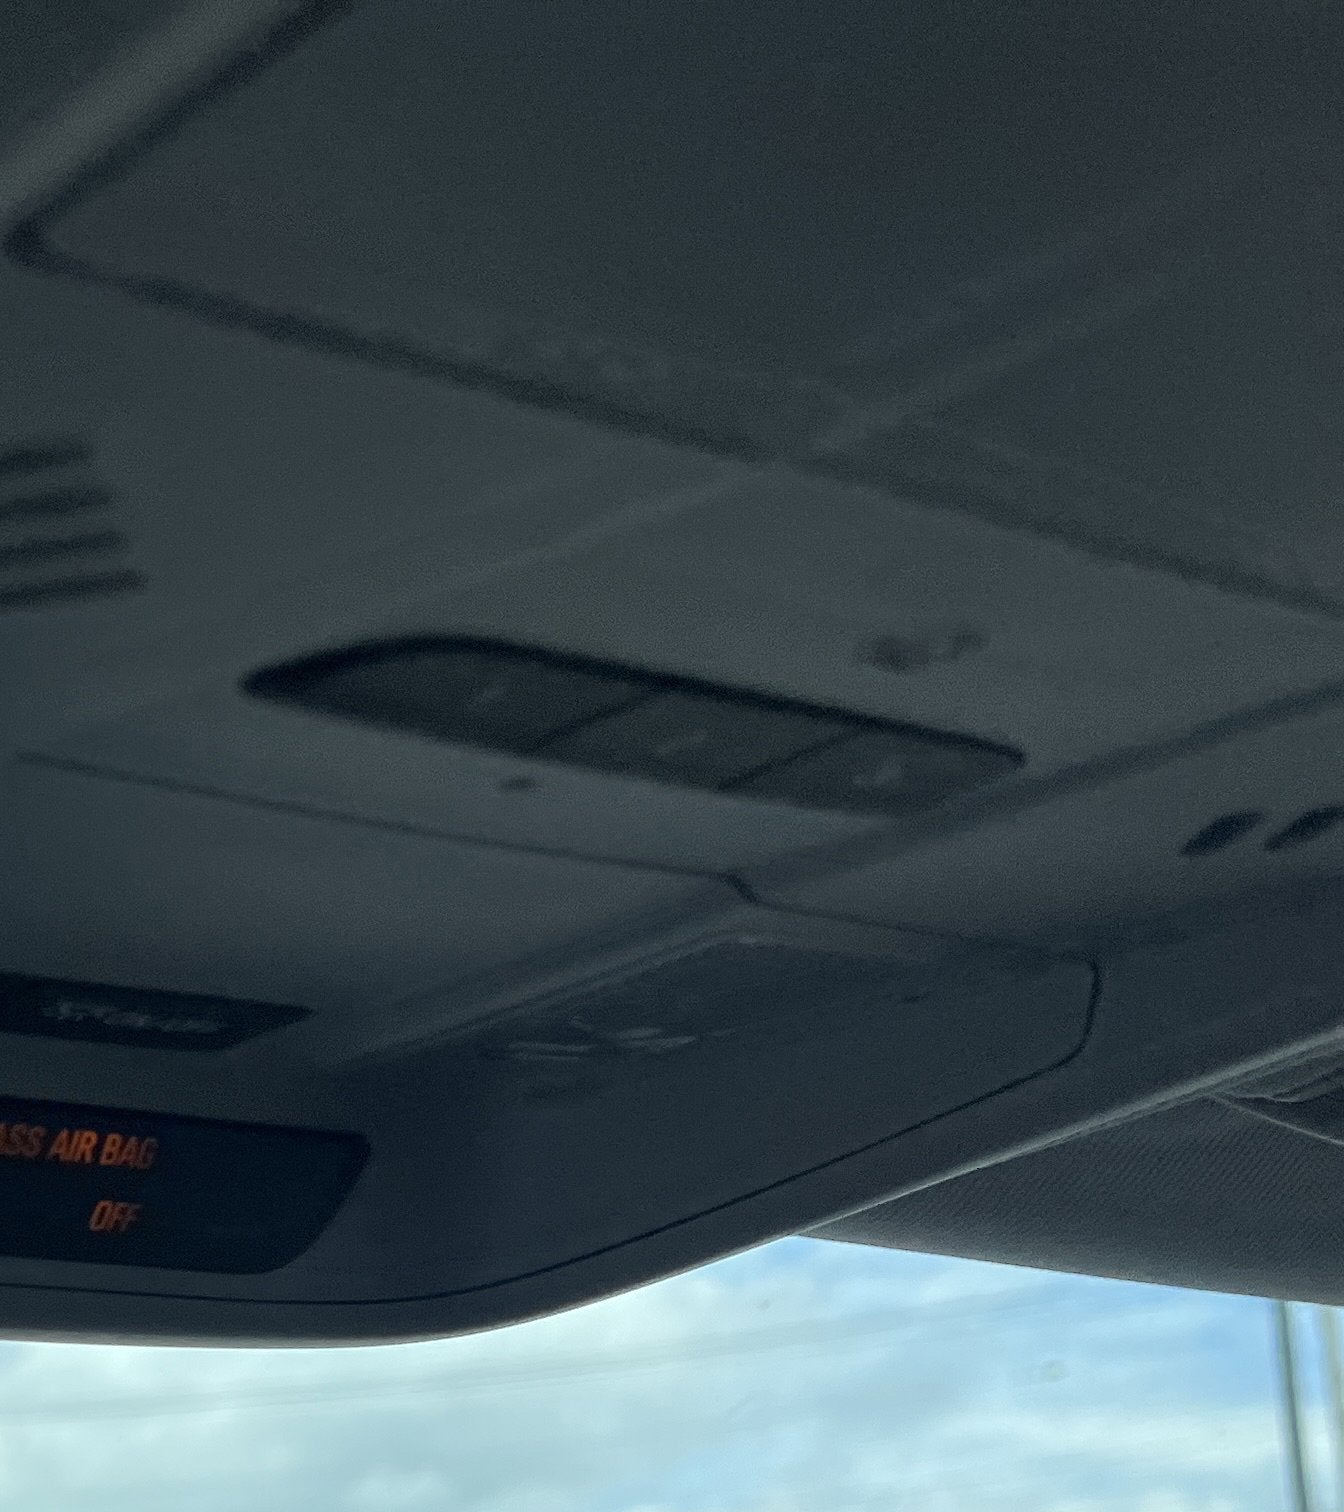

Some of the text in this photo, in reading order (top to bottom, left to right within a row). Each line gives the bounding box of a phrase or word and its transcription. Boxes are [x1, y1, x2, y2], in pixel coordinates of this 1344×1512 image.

[47, 1128, 98, 1164] AIR
[99, 1132, 159, 1168] BAG
[89, 1199, 142, 1234] OFF
